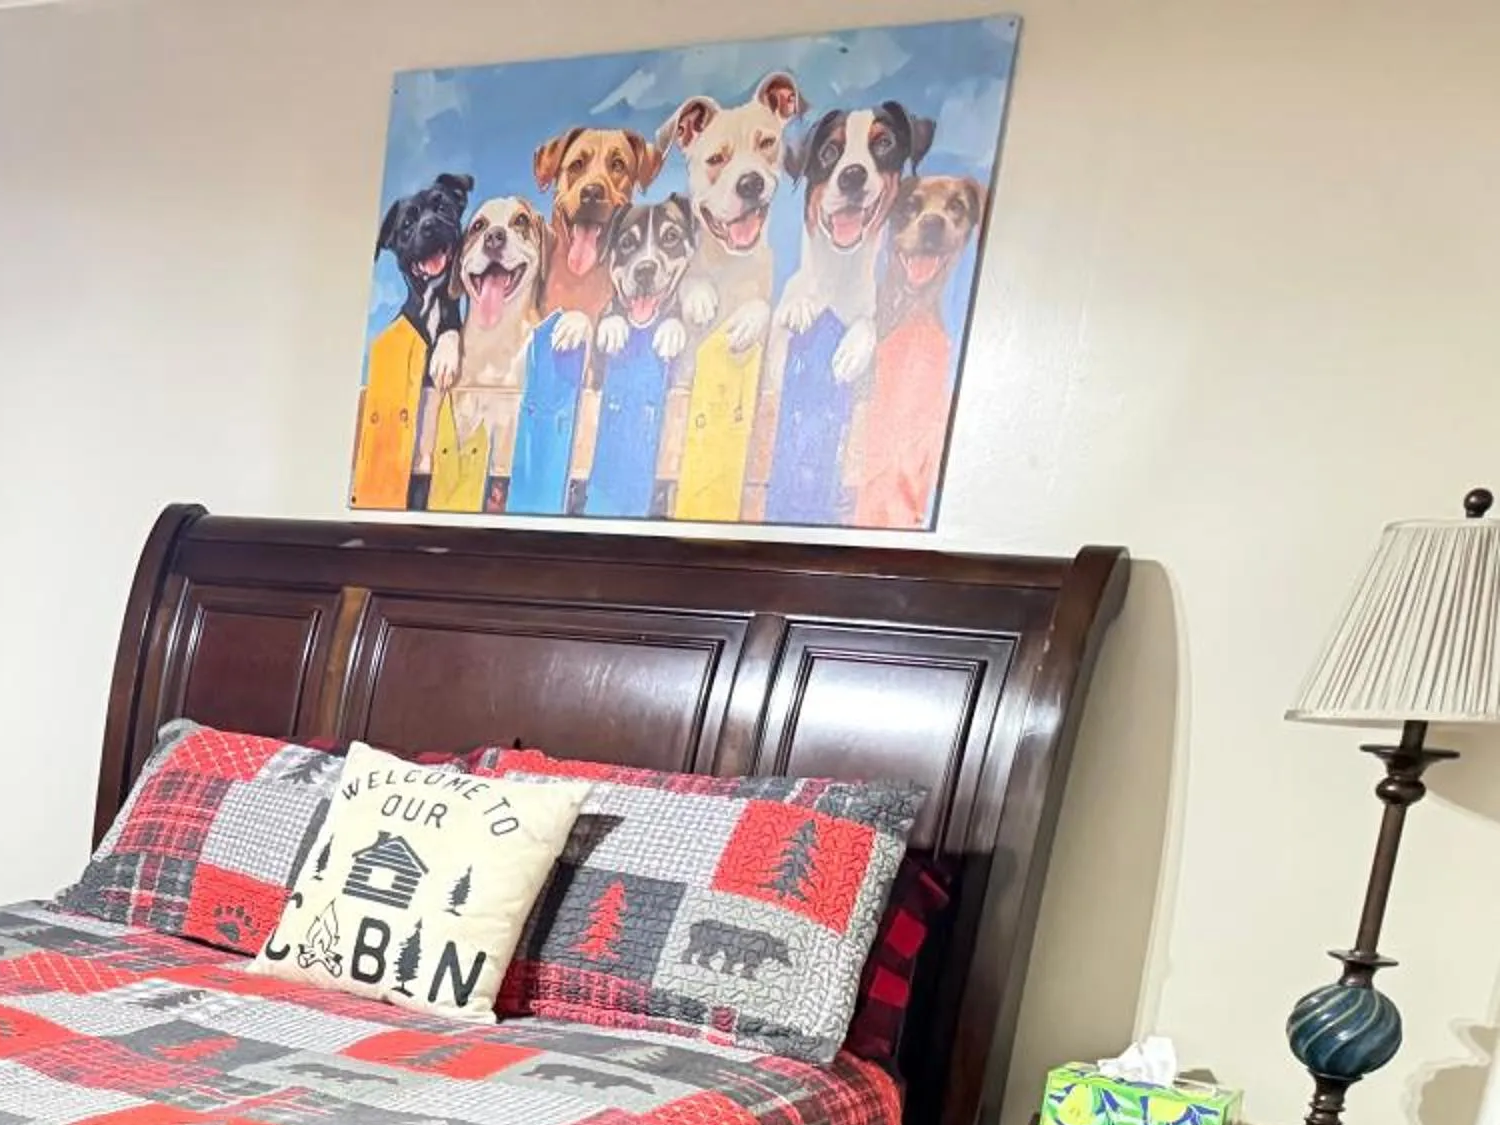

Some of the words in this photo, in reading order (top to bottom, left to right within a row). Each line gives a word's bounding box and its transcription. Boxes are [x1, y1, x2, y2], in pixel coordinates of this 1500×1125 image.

[341, 769, 489, 801] WELCOME
[483, 796, 519, 836] TO
[381, 794, 448, 828] OUR
